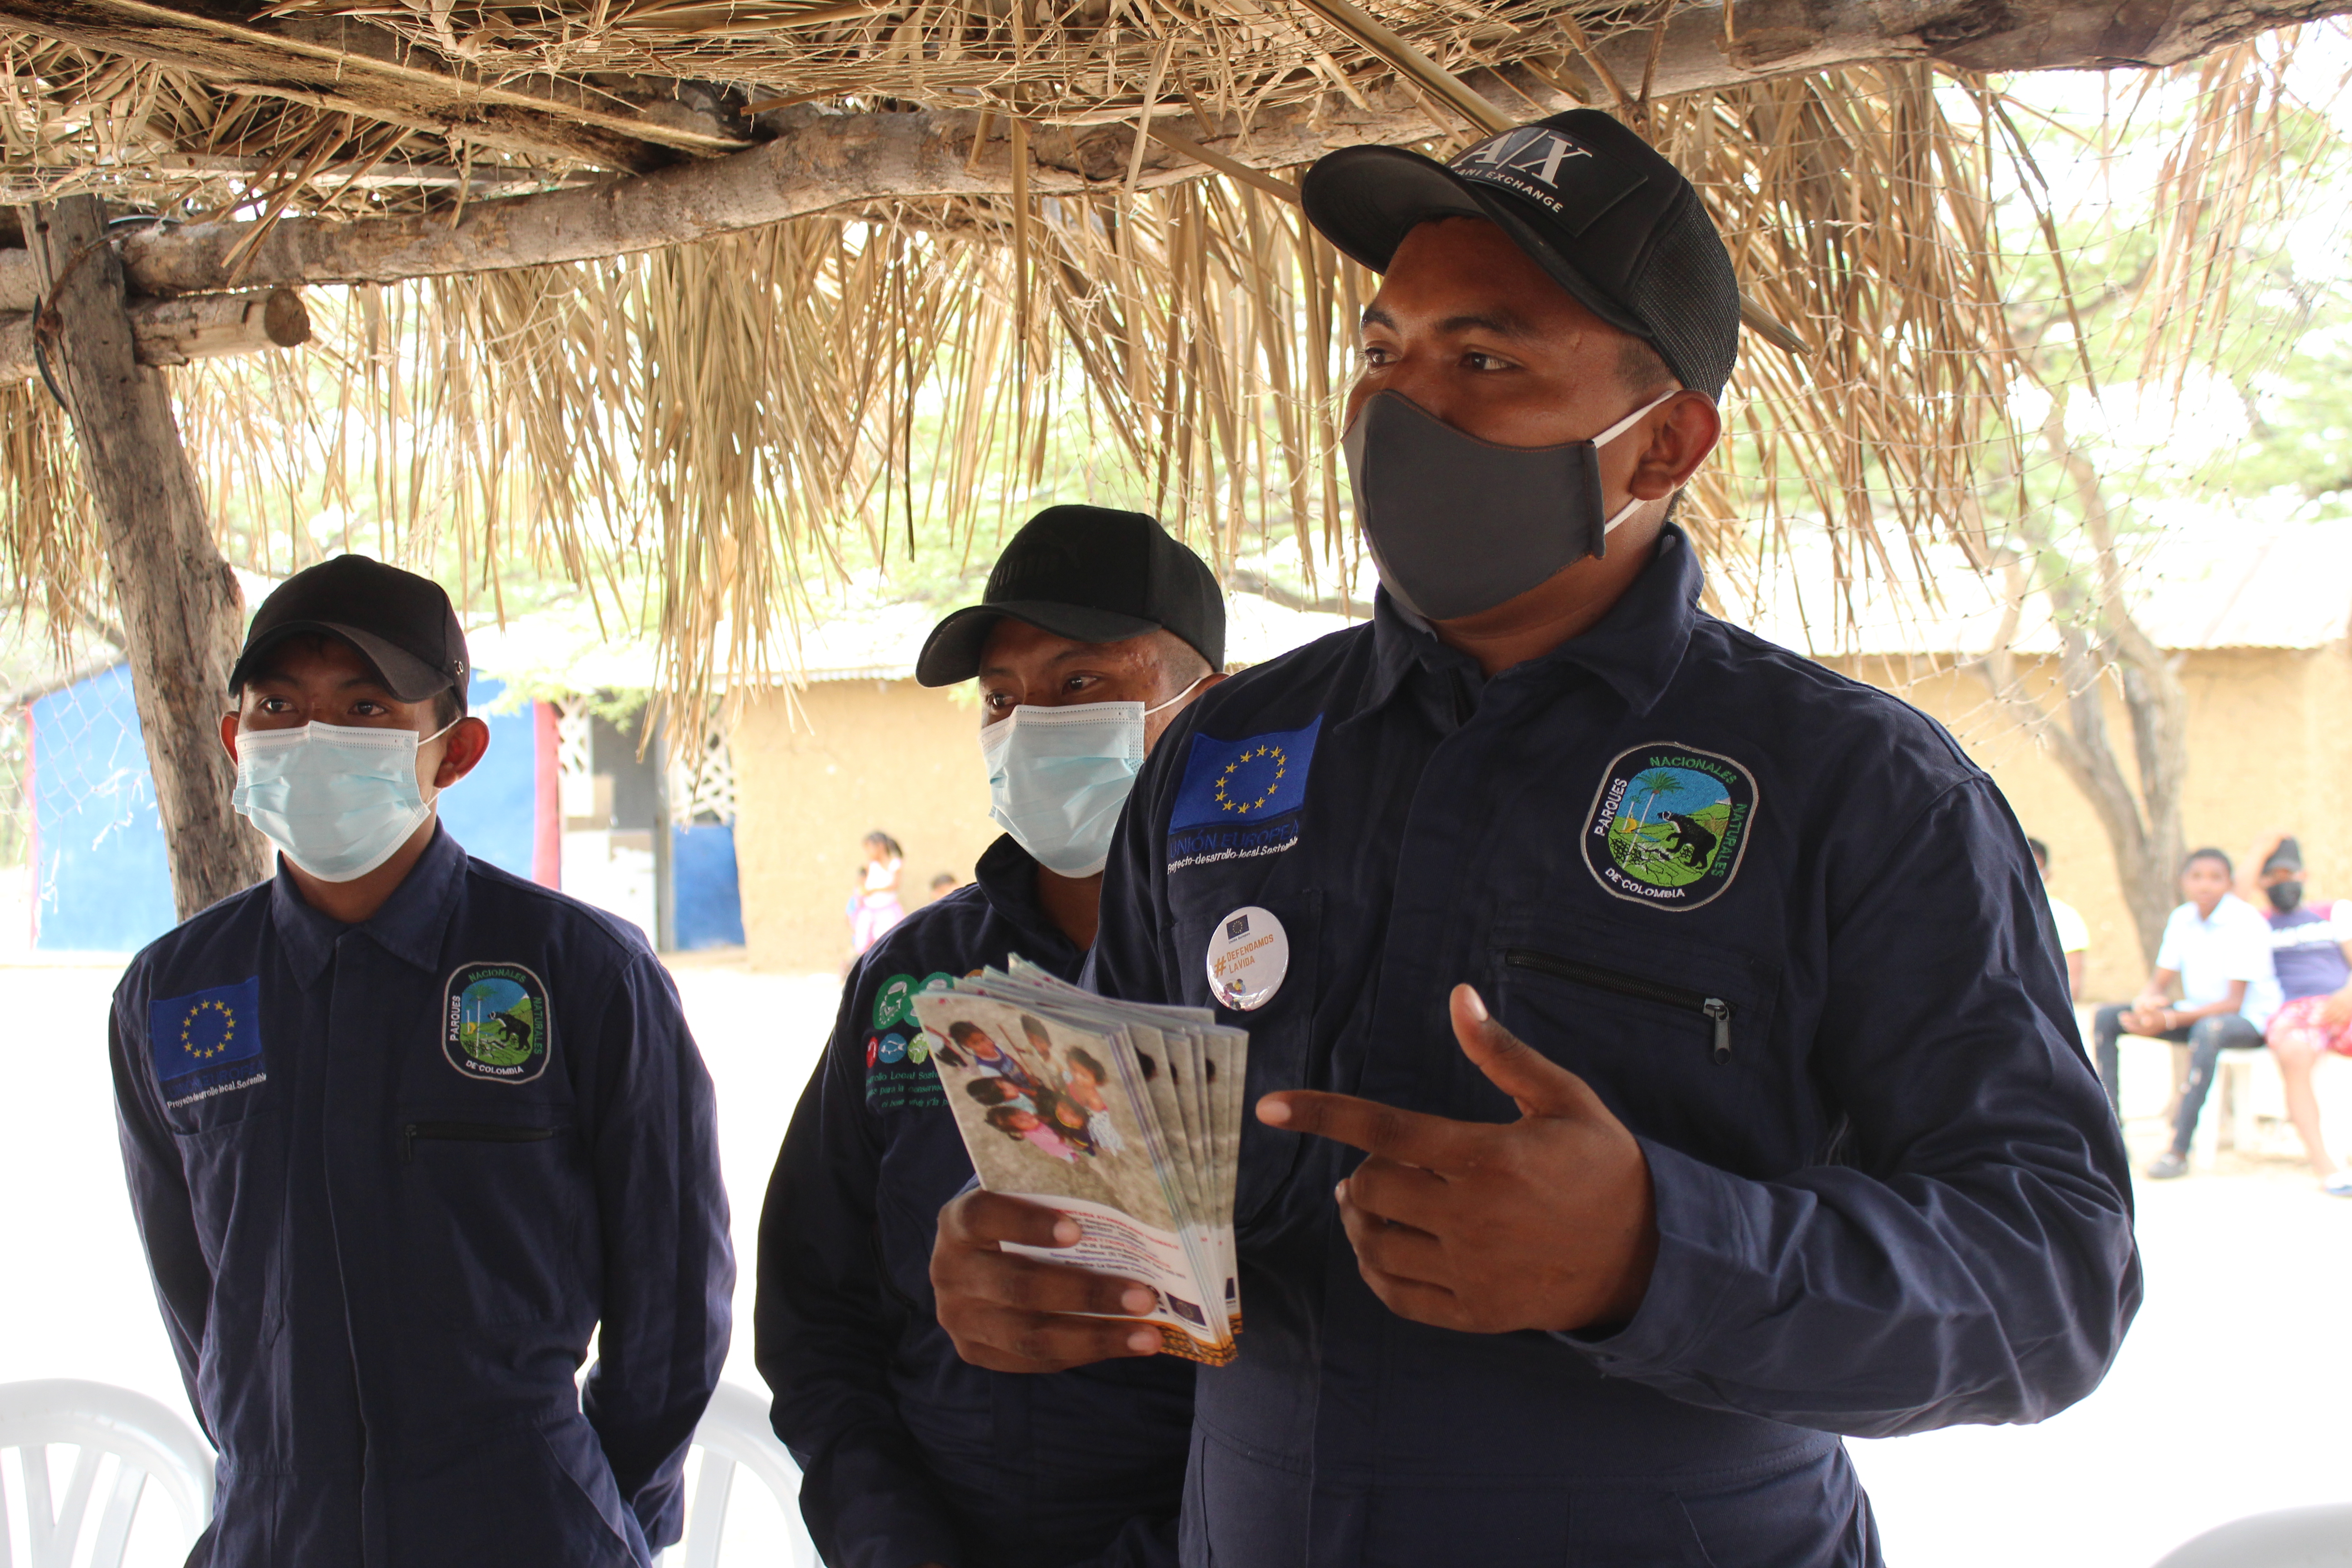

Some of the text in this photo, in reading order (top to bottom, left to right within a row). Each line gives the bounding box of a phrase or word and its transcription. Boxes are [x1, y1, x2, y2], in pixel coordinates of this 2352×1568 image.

[1485, 171, 1563, 213] EXCHANGE
[1649, 756, 1737, 784] NACIONALES
[1593, 778, 1628, 837] PARQUES
[1170, 819, 1299, 858] UNIÓN EUROPEA
[1195, 848, 1237, 865] desarrollo
[1238, 846, 1259, 858] local
[1711, 803, 1748, 877] NATURALES
[1605, 867, 1686, 898] DE COLOMBIA
[468, 968, 526, 983] NACIONALES
[450, 995, 461, 1041] PARQUES
[533, 997, 544, 1055] NATURALES
[466, 1059, 524, 1075] DE COLOMBIA
[890, 1071, 916, 1080] Local
